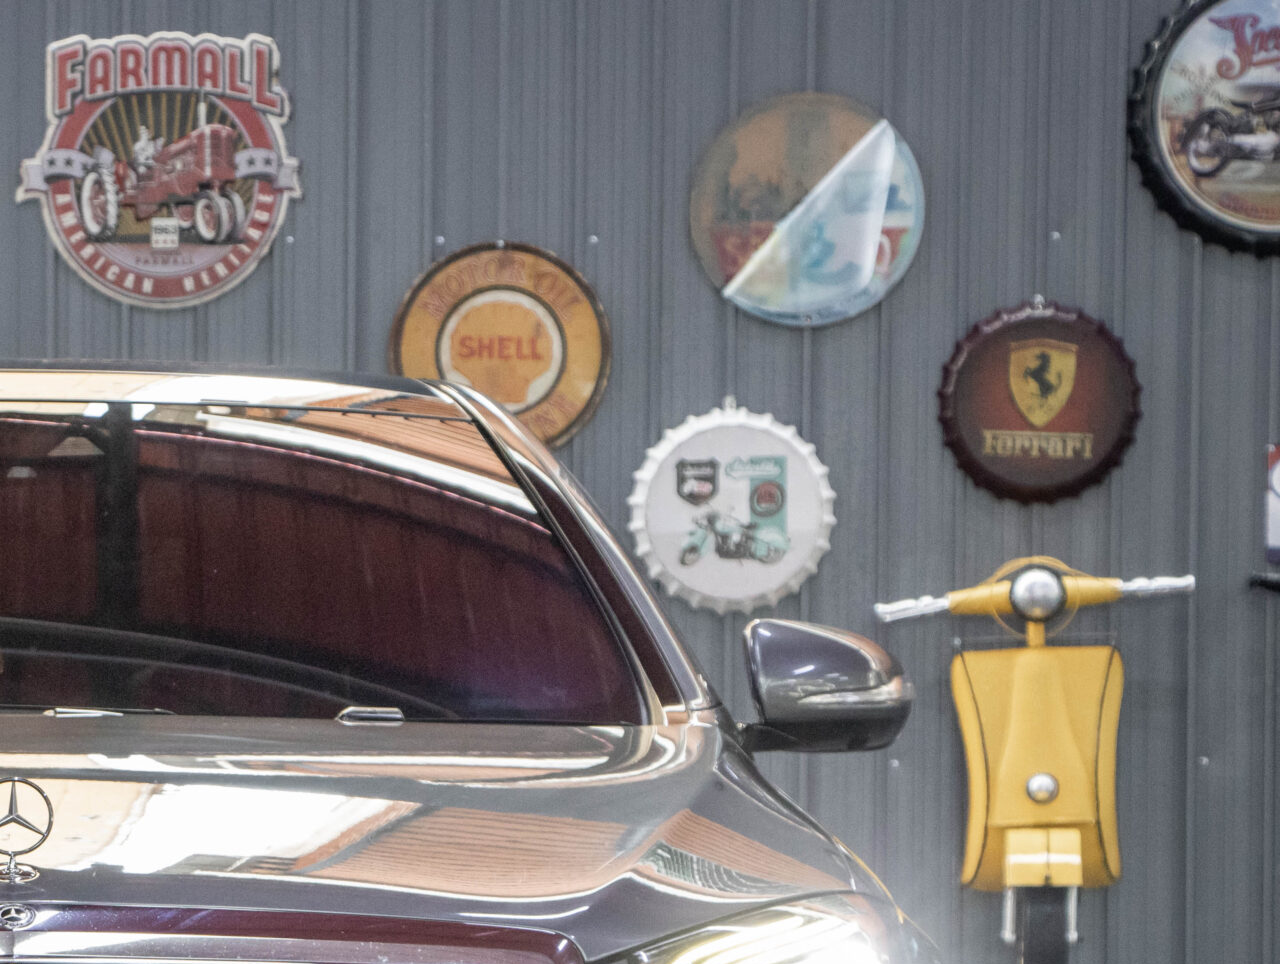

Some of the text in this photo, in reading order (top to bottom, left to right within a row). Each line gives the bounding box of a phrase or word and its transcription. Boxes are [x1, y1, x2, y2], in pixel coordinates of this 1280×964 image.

[55, 42, 284, 113] FARMALL
[55, 192, 154, 294] AMERICAN
[422, 257, 584, 322] MOTOR OIL
[458, 336, 543, 361] SHELL
[981, 429, 1094, 459] Ferrari
